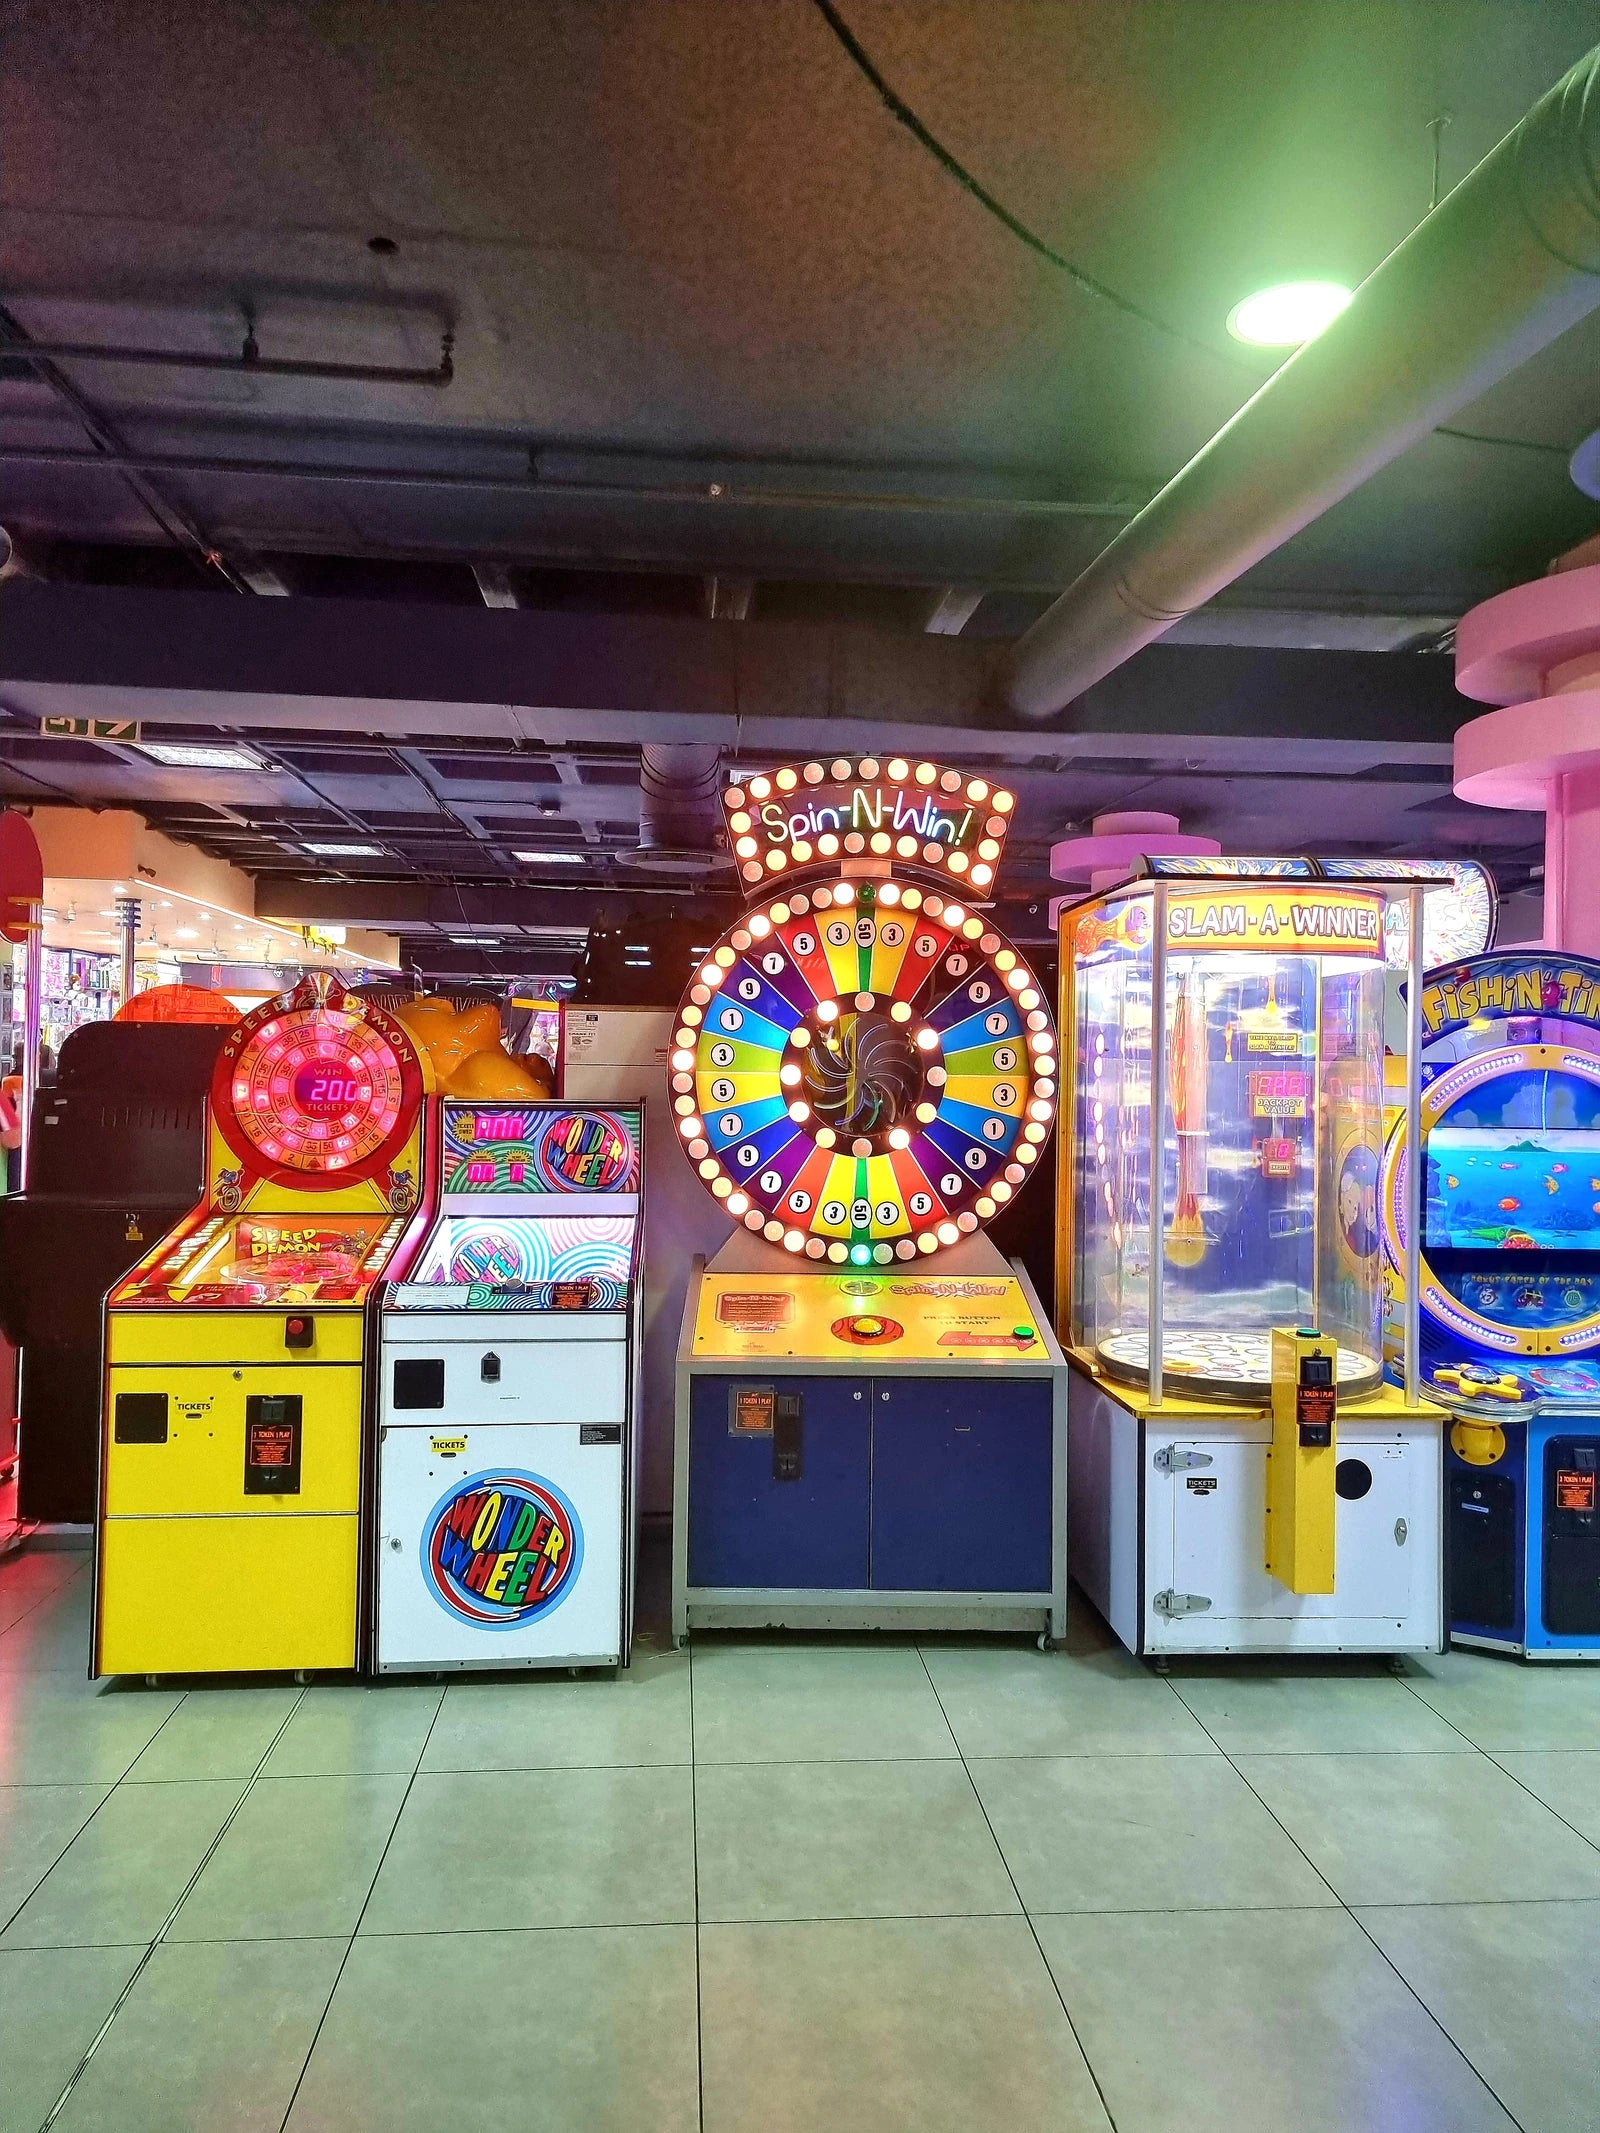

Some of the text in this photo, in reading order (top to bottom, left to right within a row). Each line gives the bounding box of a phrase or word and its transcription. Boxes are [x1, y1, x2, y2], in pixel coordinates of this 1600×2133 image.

[761, 787, 973, 846] Spin-N-Win!
[223, 1000, 284, 1058] SPEED
[314, 1068, 343, 1076] WIN
[306, 1103, 349, 1112] TICKETS
[1258, 1099, 1302, 1107] JACKPOT
[1264, 1106, 1296, 1114] VALUE
[552, 1116, 624, 1163] WONDER
[546, 1138, 614, 1187] WHEEL
[251, 1226, 317, 1244] SPEED
[251, 1242, 321, 1257] DEMON
[1303, 1390, 1319, 1398] TOKEN
[176, 1403, 211, 1411] TICKETS
[743, 1397, 757, 1405] TOKEN
[432, 1441, 465, 1449] TICKETS
[449, 1491, 566, 1565] WONDER
[439, 1525, 548, 1604] WHEEL
